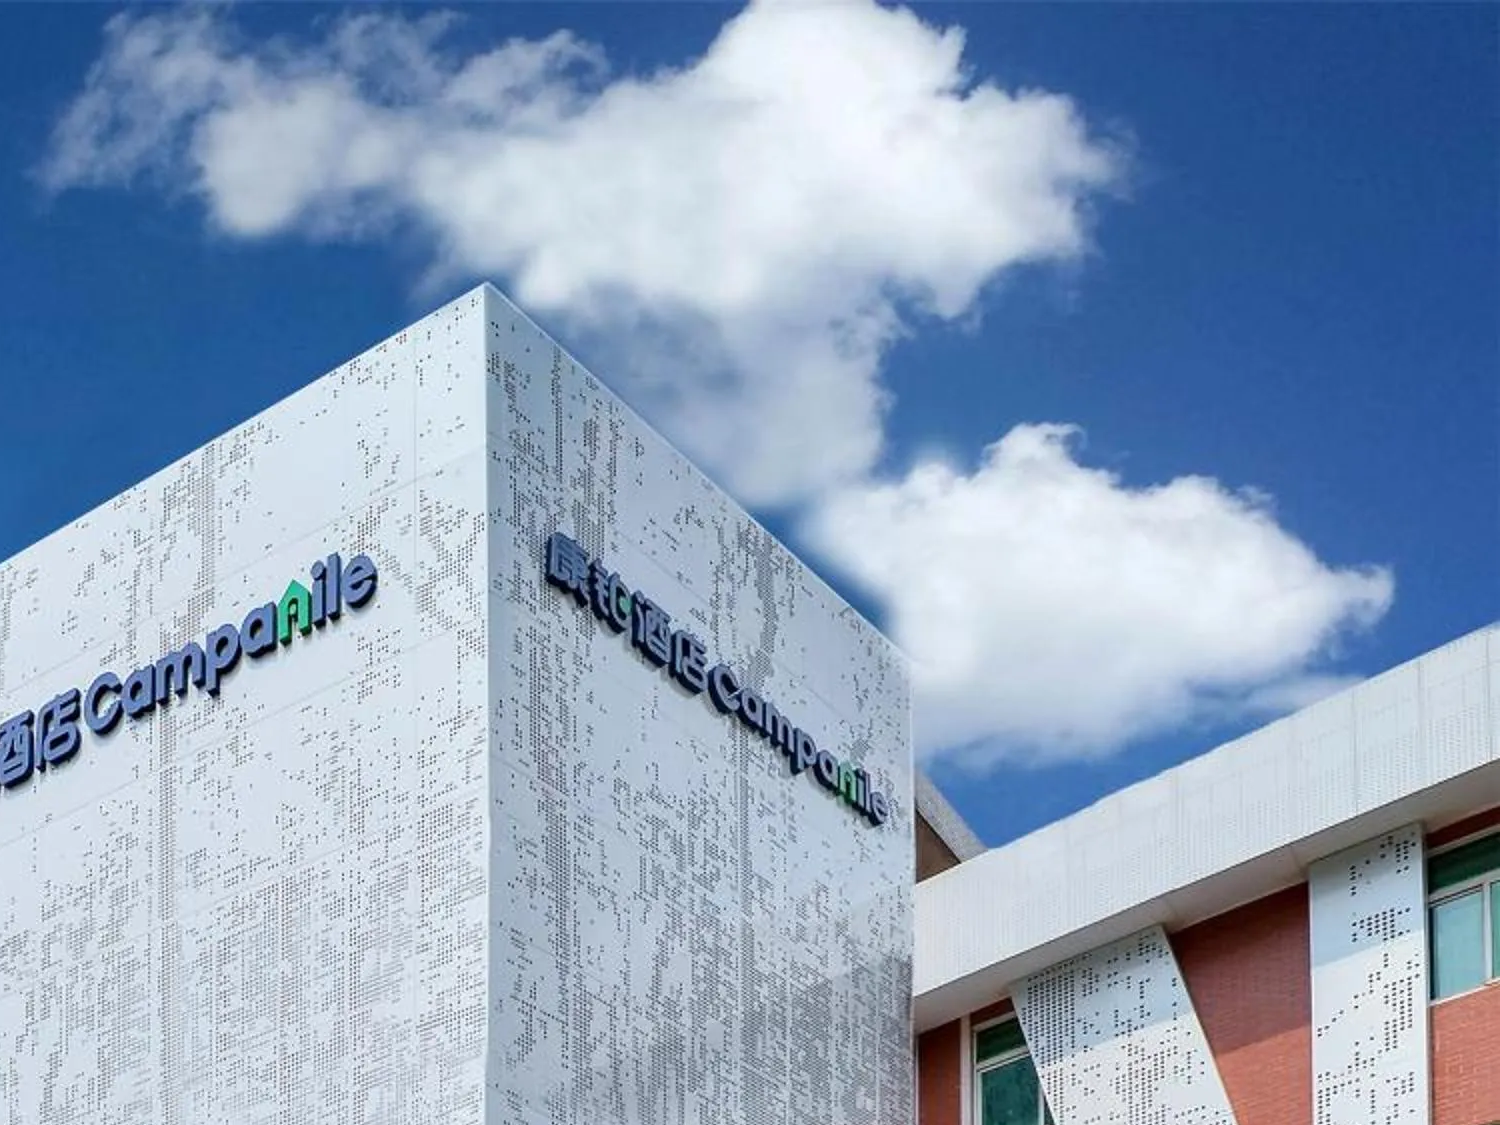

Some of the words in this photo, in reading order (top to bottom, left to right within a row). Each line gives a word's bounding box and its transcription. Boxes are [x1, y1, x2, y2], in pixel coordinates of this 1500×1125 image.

[83, 552, 378, 735] Campanile
[546, 532, 708, 694] 康铂酒店
[708, 664, 888, 827] Campanile
